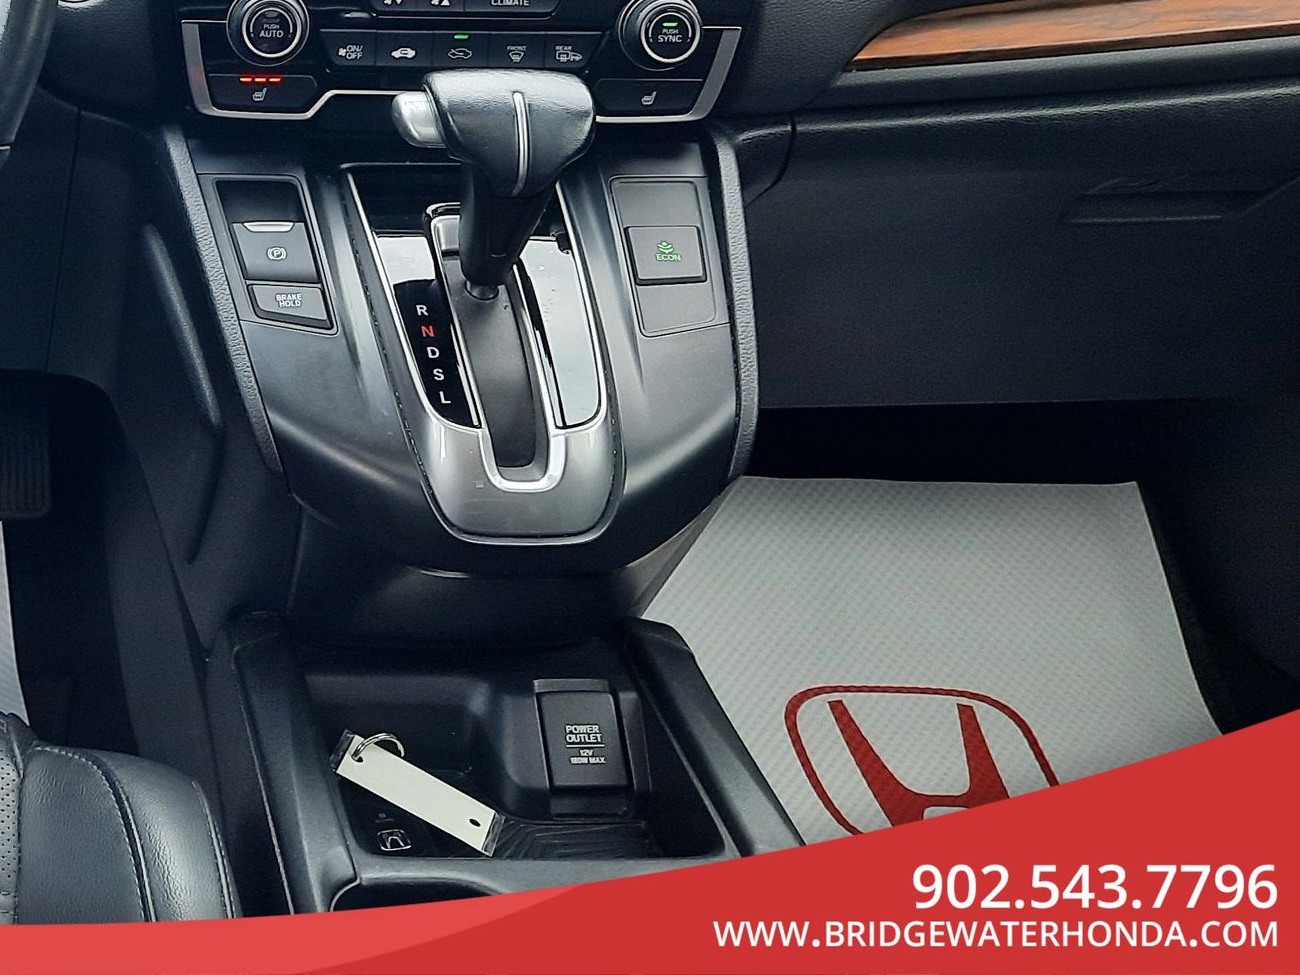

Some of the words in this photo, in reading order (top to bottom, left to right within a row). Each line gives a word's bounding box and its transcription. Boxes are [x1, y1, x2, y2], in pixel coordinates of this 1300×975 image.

[259, 30, 284, 38] AUTO
[657, 34, 682, 43] SYNC
[346, 52, 363, 60] OFF
[656, 253, 682, 261] ECON
[275, 293, 303, 301] BRAKE
[279, 300, 302, 308] HOLD
[416, 305, 429, 316] R
[421, 326, 435, 338] N
[426, 346, 440, 359] D
[433, 368, 445, 381] S
[439, 391, 452, 404] L
[565, 725, 600, 734] POWER
[565, 733, 602, 743] OUTLET
